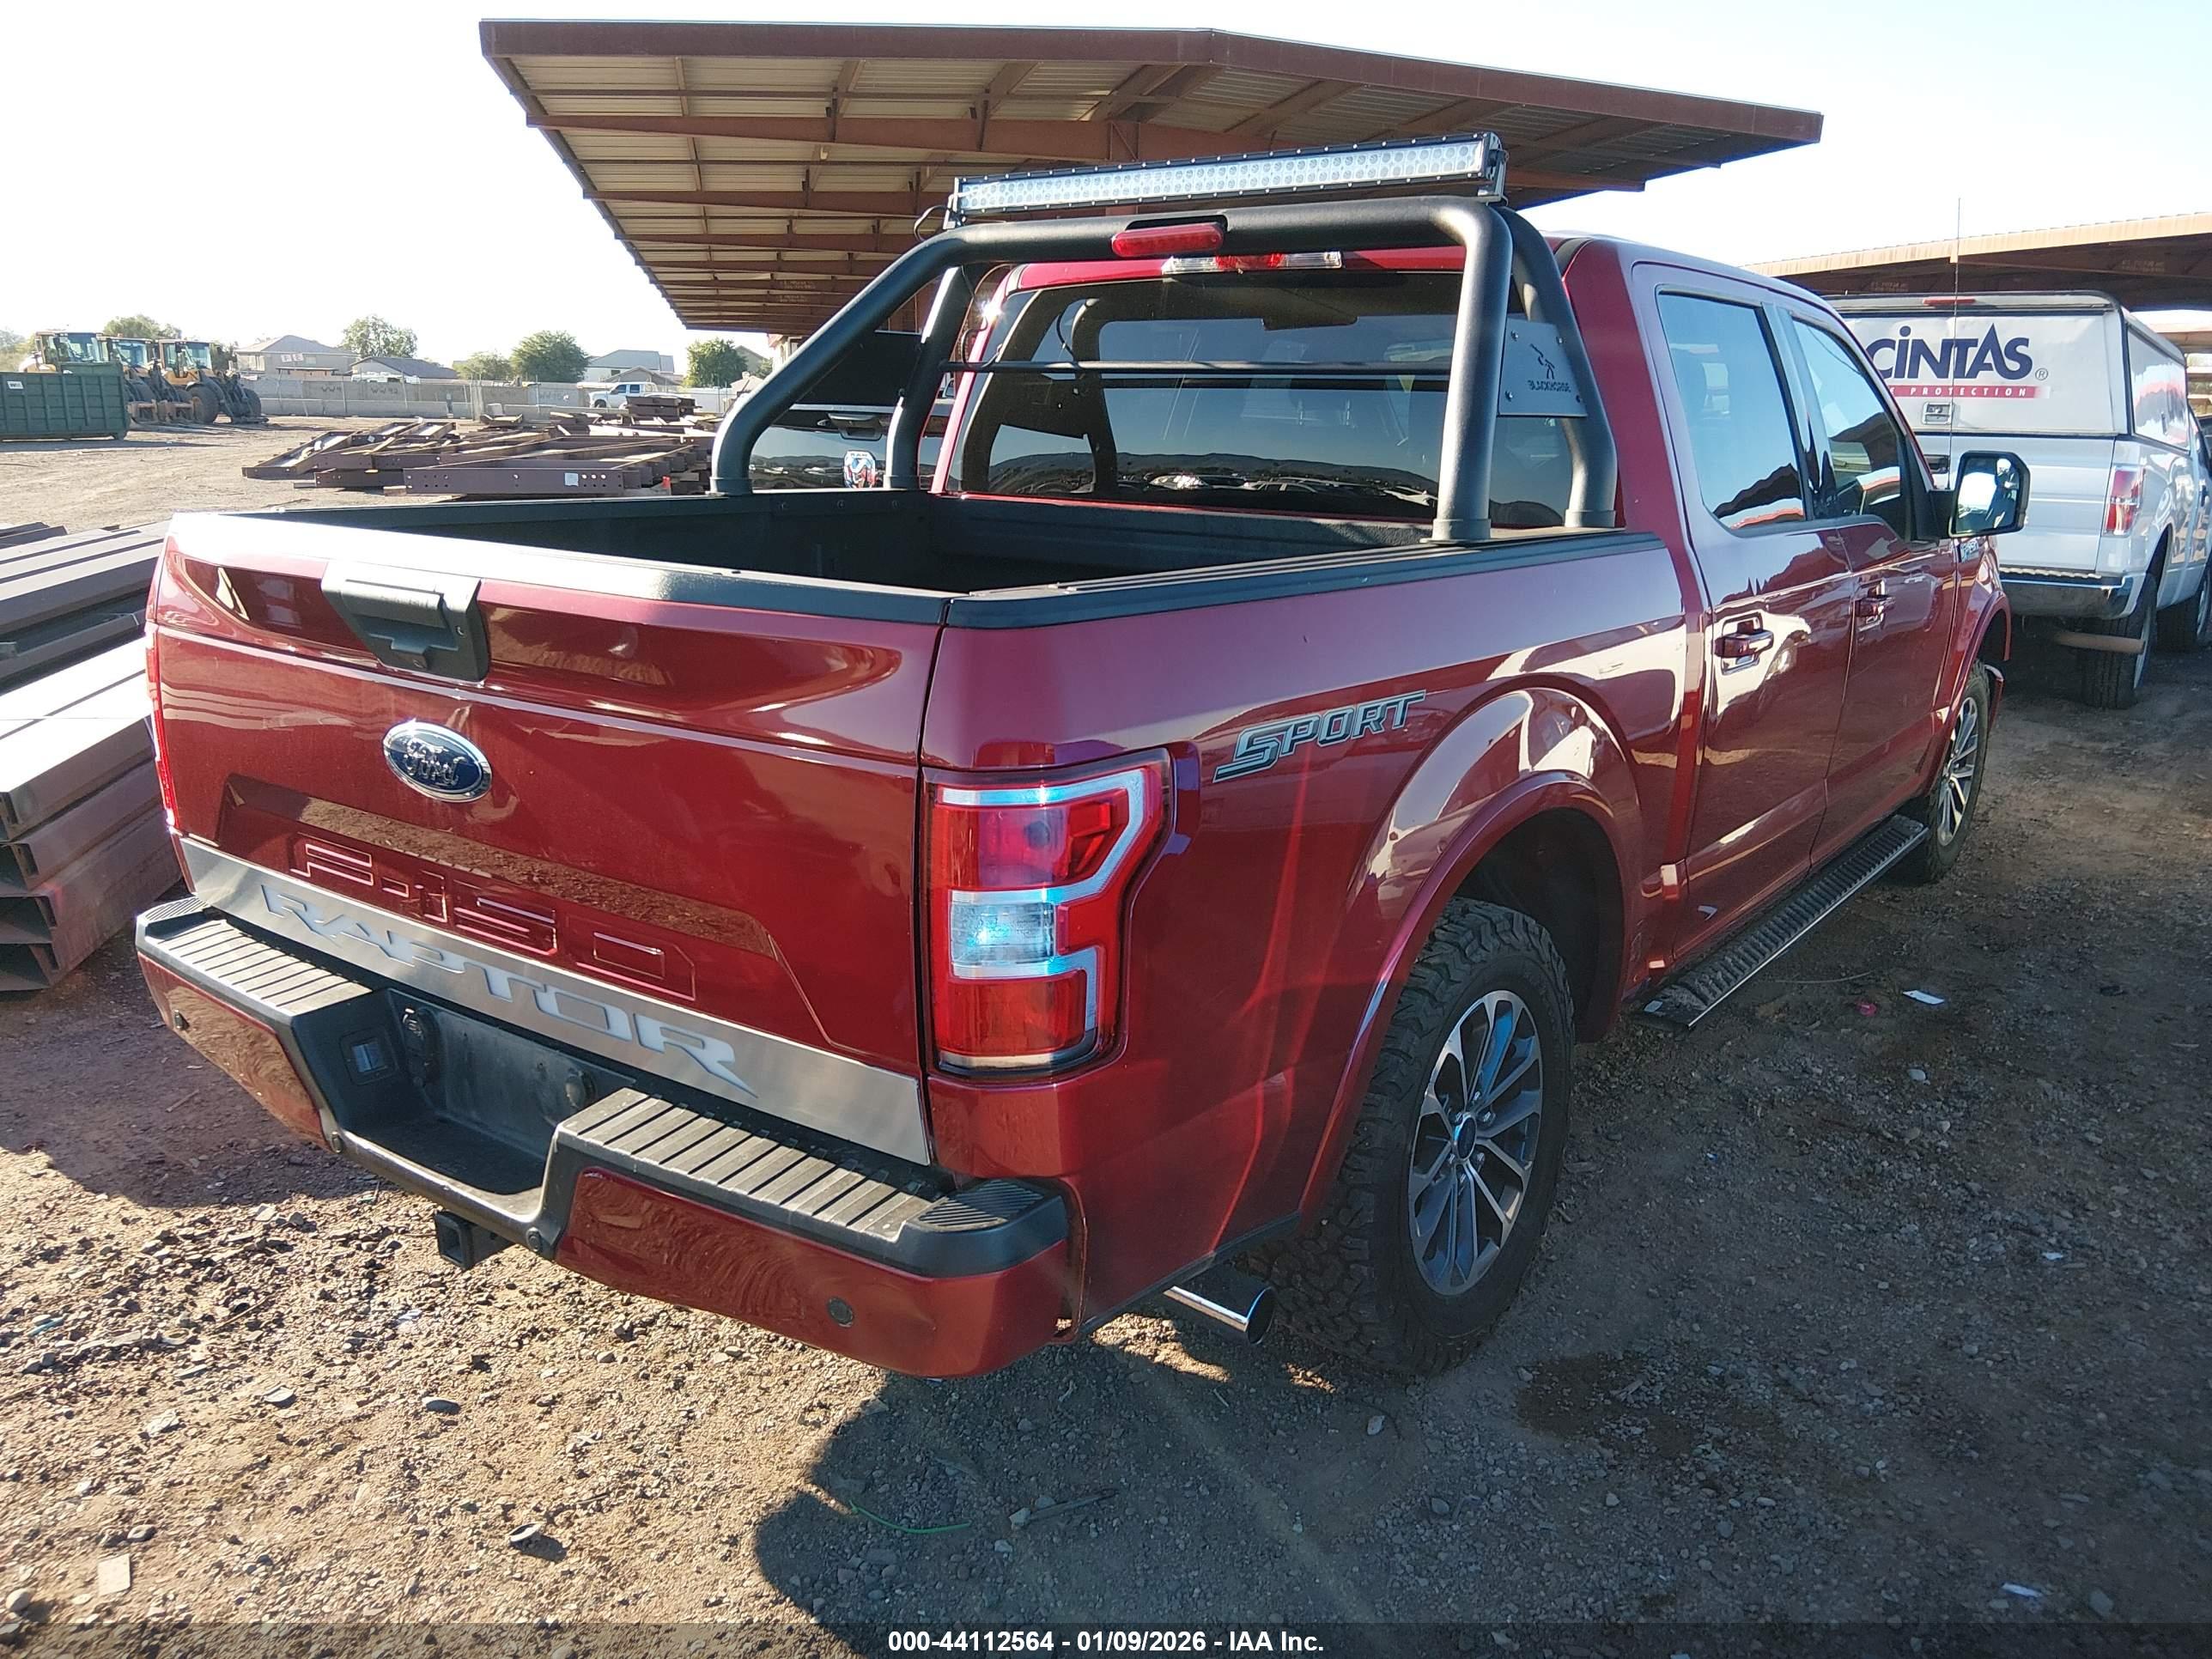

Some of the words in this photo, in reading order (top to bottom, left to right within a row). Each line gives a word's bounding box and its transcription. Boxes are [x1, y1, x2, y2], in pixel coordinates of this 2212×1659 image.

[1911, 386, 2027, 396] PROTECTION
[1212, 690, 1426, 783] SPORT
[289, 831, 696, 1002] F-150
[260, 883, 759, 1099] RAPTOR
